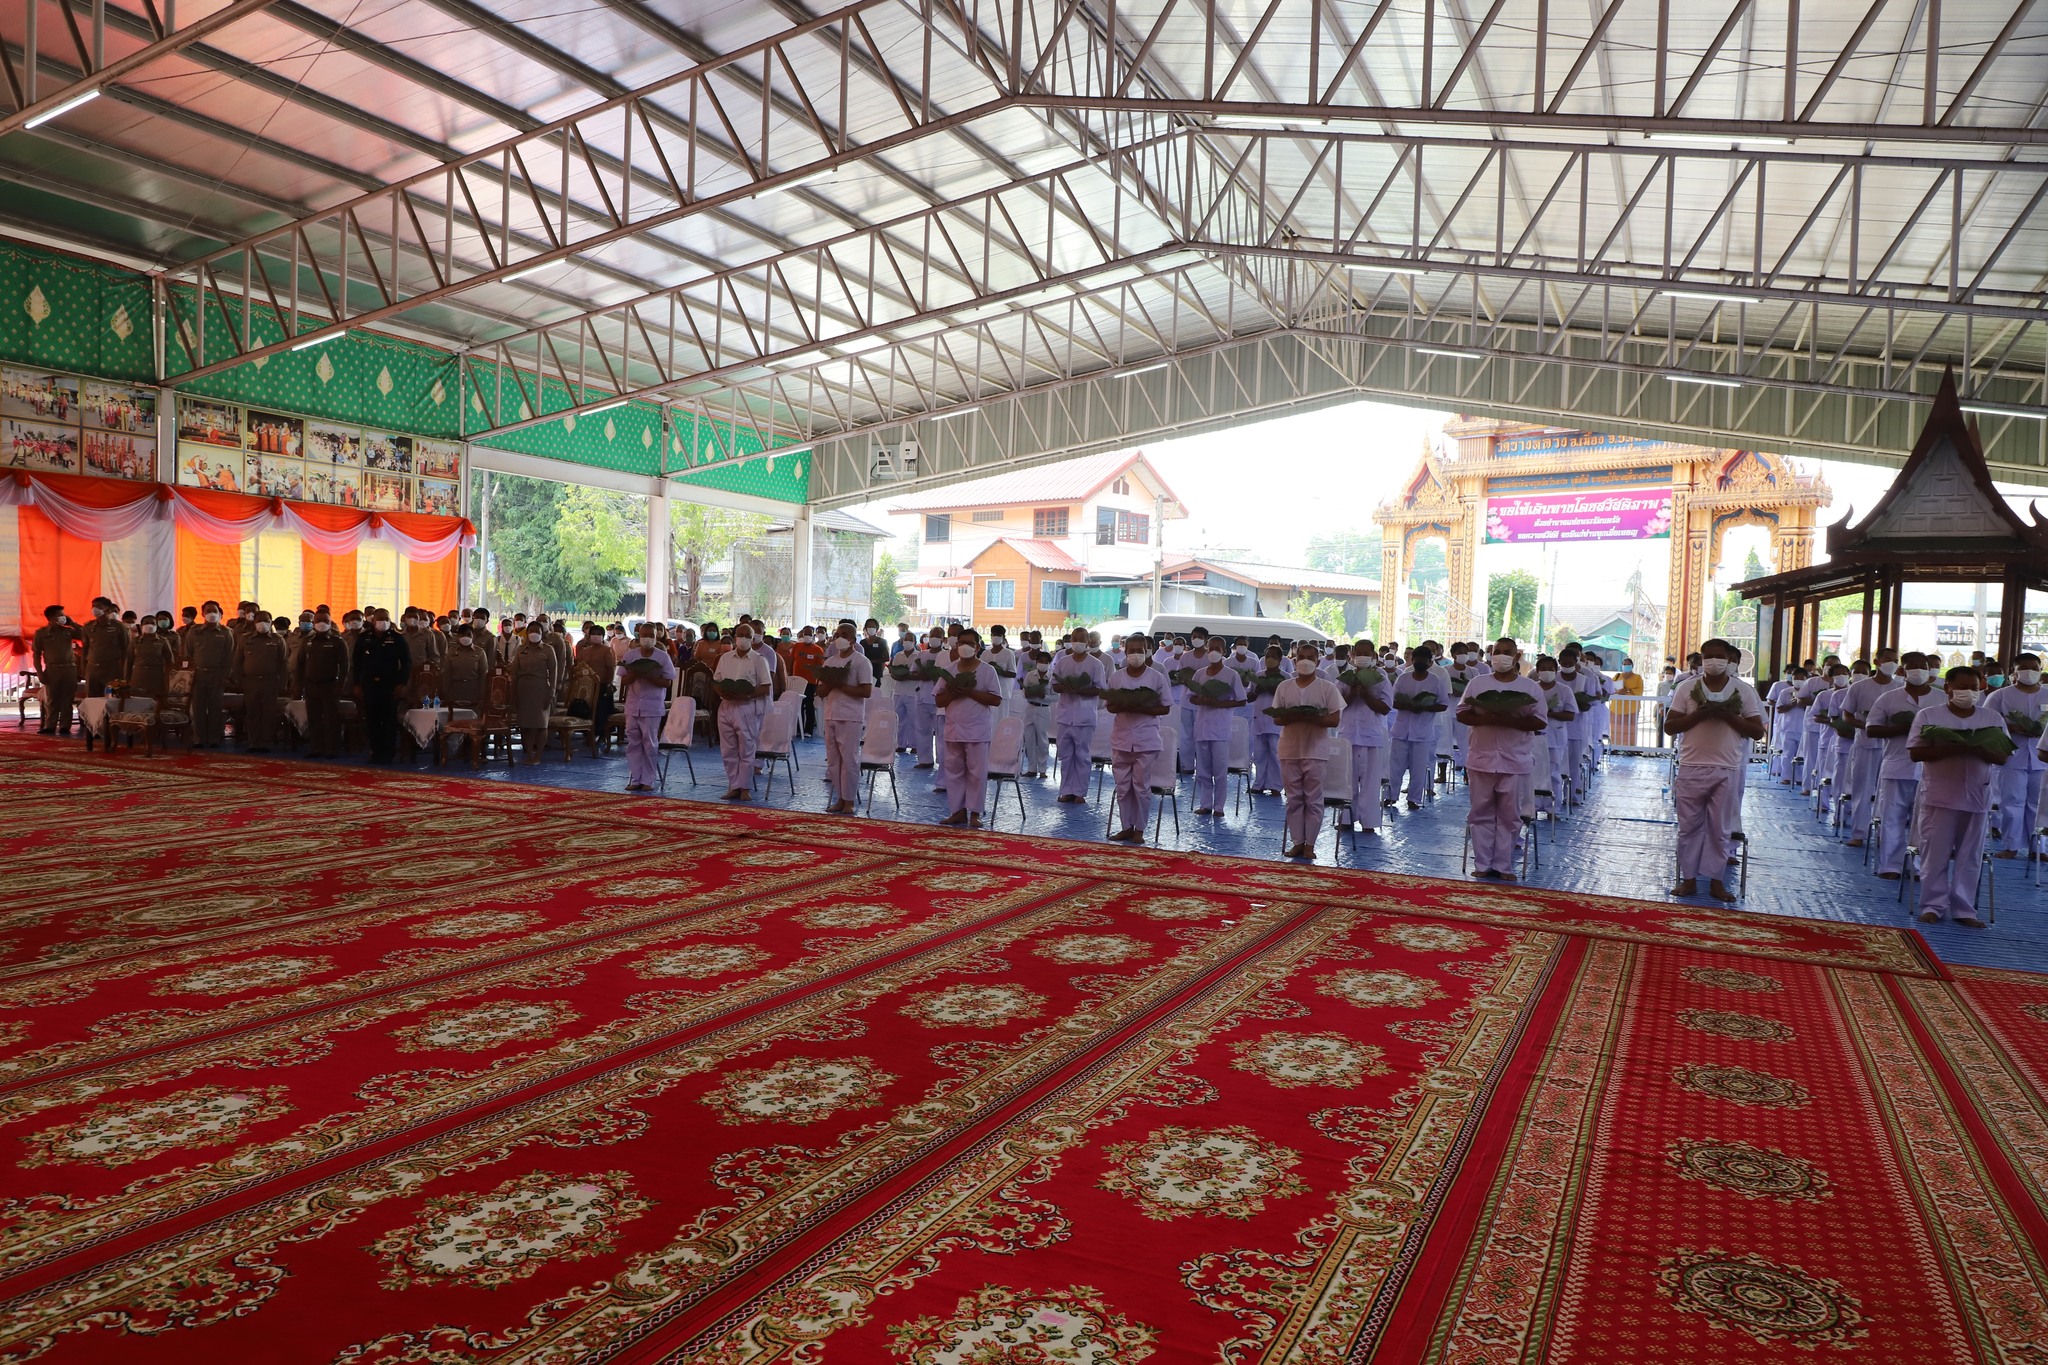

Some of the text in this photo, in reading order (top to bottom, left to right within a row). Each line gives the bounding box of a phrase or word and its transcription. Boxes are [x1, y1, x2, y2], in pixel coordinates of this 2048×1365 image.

[1499, 496, 1660, 516] ขอให้เดินทางโดยสวัสดิภาพ
